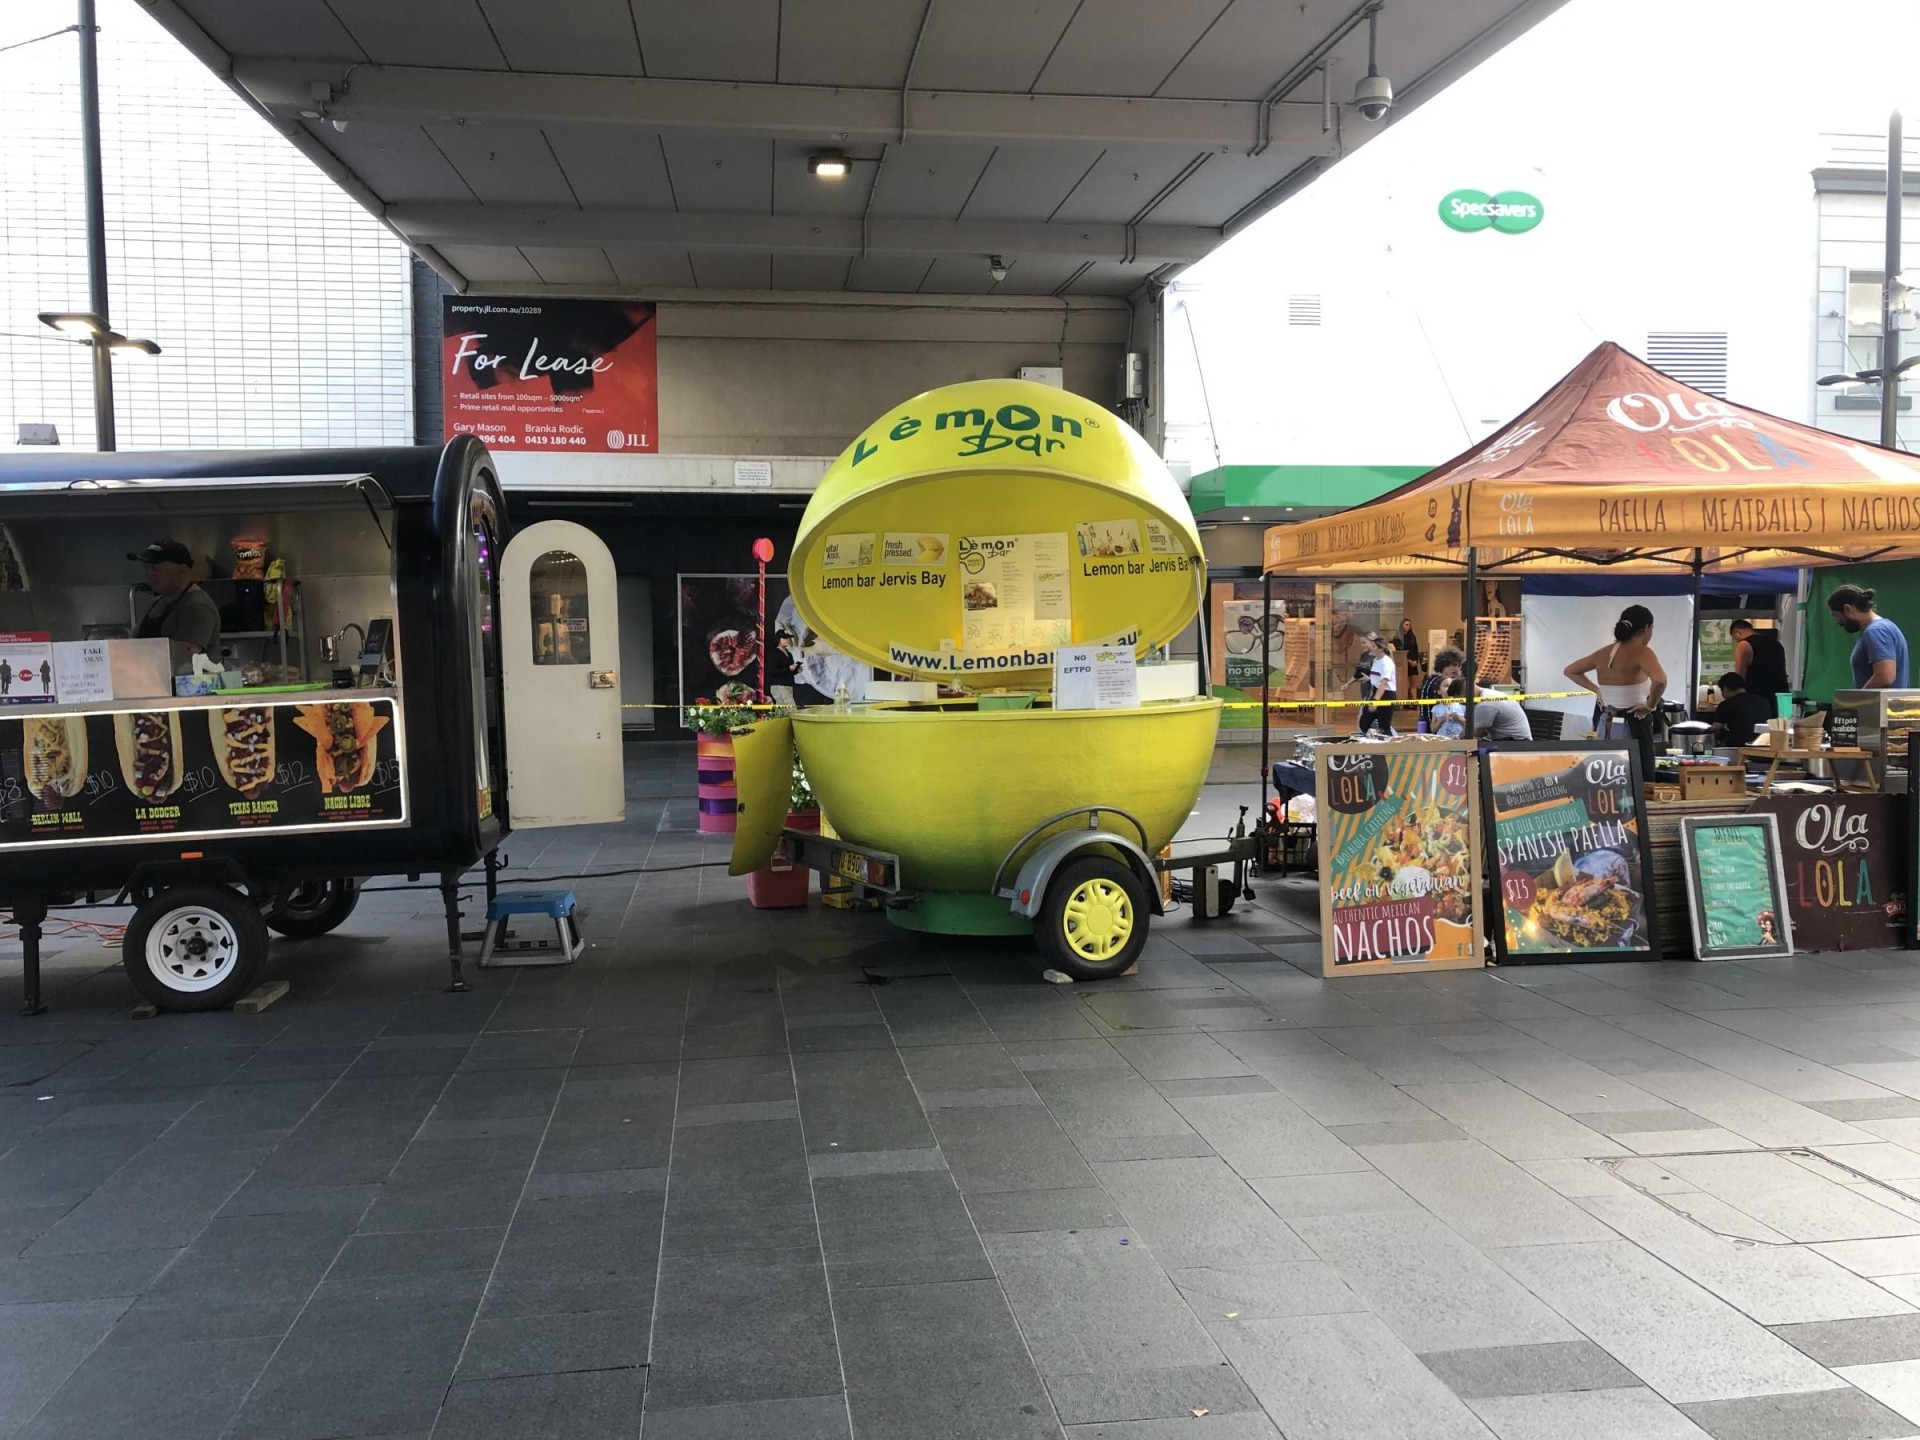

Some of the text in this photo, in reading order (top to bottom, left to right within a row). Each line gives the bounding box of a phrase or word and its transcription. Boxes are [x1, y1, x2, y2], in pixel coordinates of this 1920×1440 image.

[1450, 198, 1537, 219] Specsavers
[451, 304, 542, 314] property.jll.com.au/10289
[452, 334, 614, 381] For Lease
[516, 394, 543, 402] 100sqm
[482, 404, 500, 412] retail
[501, 404, 516, 412] mall
[517, 405, 564, 414] opportunities
[1606, 392, 1740, 433] Ola
[453, 422, 506, 433] Gary Mason
[525, 424, 584, 434] Branka Rodic
[957, 418, 1066, 457] bar
[497, 436, 516, 444] 404
[525, 436, 587, 446] 0419 180 440
[625, 434, 650, 447] JLL
[1636, 432, 1814, 474] LOLA
[1500, 492, 1534, 513] Ola
[1499, 515, 1534, 536] LOLA
[1599, 496, 1920, 534] PAELLA MEATBALLS NACHOS
[1374, 512, 1407, 545] NACHOS
[826, 544, 839, 552] vital
[884, 548, 914, 560] pressed.
[885, 540, 902, 550] fresh
[987, 546, 1011, 559] bar
[1083, 562, 1125, 577] Lemon
[1127, 560, 1145, 575] bar
[1149, 556, 1176, 573] Jervis
[822, 570, 946, 590] Lemon bar Jervis Bay
[1074, 654, 1087, 662] NO
[1244, 667, 1264, 677] gap
[1834, 716, 1858, 726] Eftpos
[84, 770, 114, 796] $10
[183, 766, 216, 793] $10
[275, 760, 310, 786] $12
[371, 760, 400, 786] $15
[1585, 759, 1627, 786] Ola
[1330, 774, 1376, 807] LOLA
[1510, 782, 1535, 794] FOLLOW
[228, 800, 279, 816] TEXAS RANGER
[324, 794, 371, 810] NACHO LIBRE
[1587, 789, 1631, 815] LOLA
[62, 812, 82, 824] WALL
[135, 806, 180, 820] LA DODGER
[1499, 808, 1582, 837] TRY OUR DELICIOUS
[1795, 803, 1869, 853] Ola
[1497, 818, 1629, 866] SPANISH PAELLA
[1331, 884, 1361, 903] beef
[1385, 876, 1464, 895] vegetarian
[1506, 878, 1530, 903] $15
[1797, 858, 1876, 909] LOLA
[1332, 901, 1420, 924] AUTHENTIC MEXICAN
[1334, 915, 1435, 962] NACHOS
